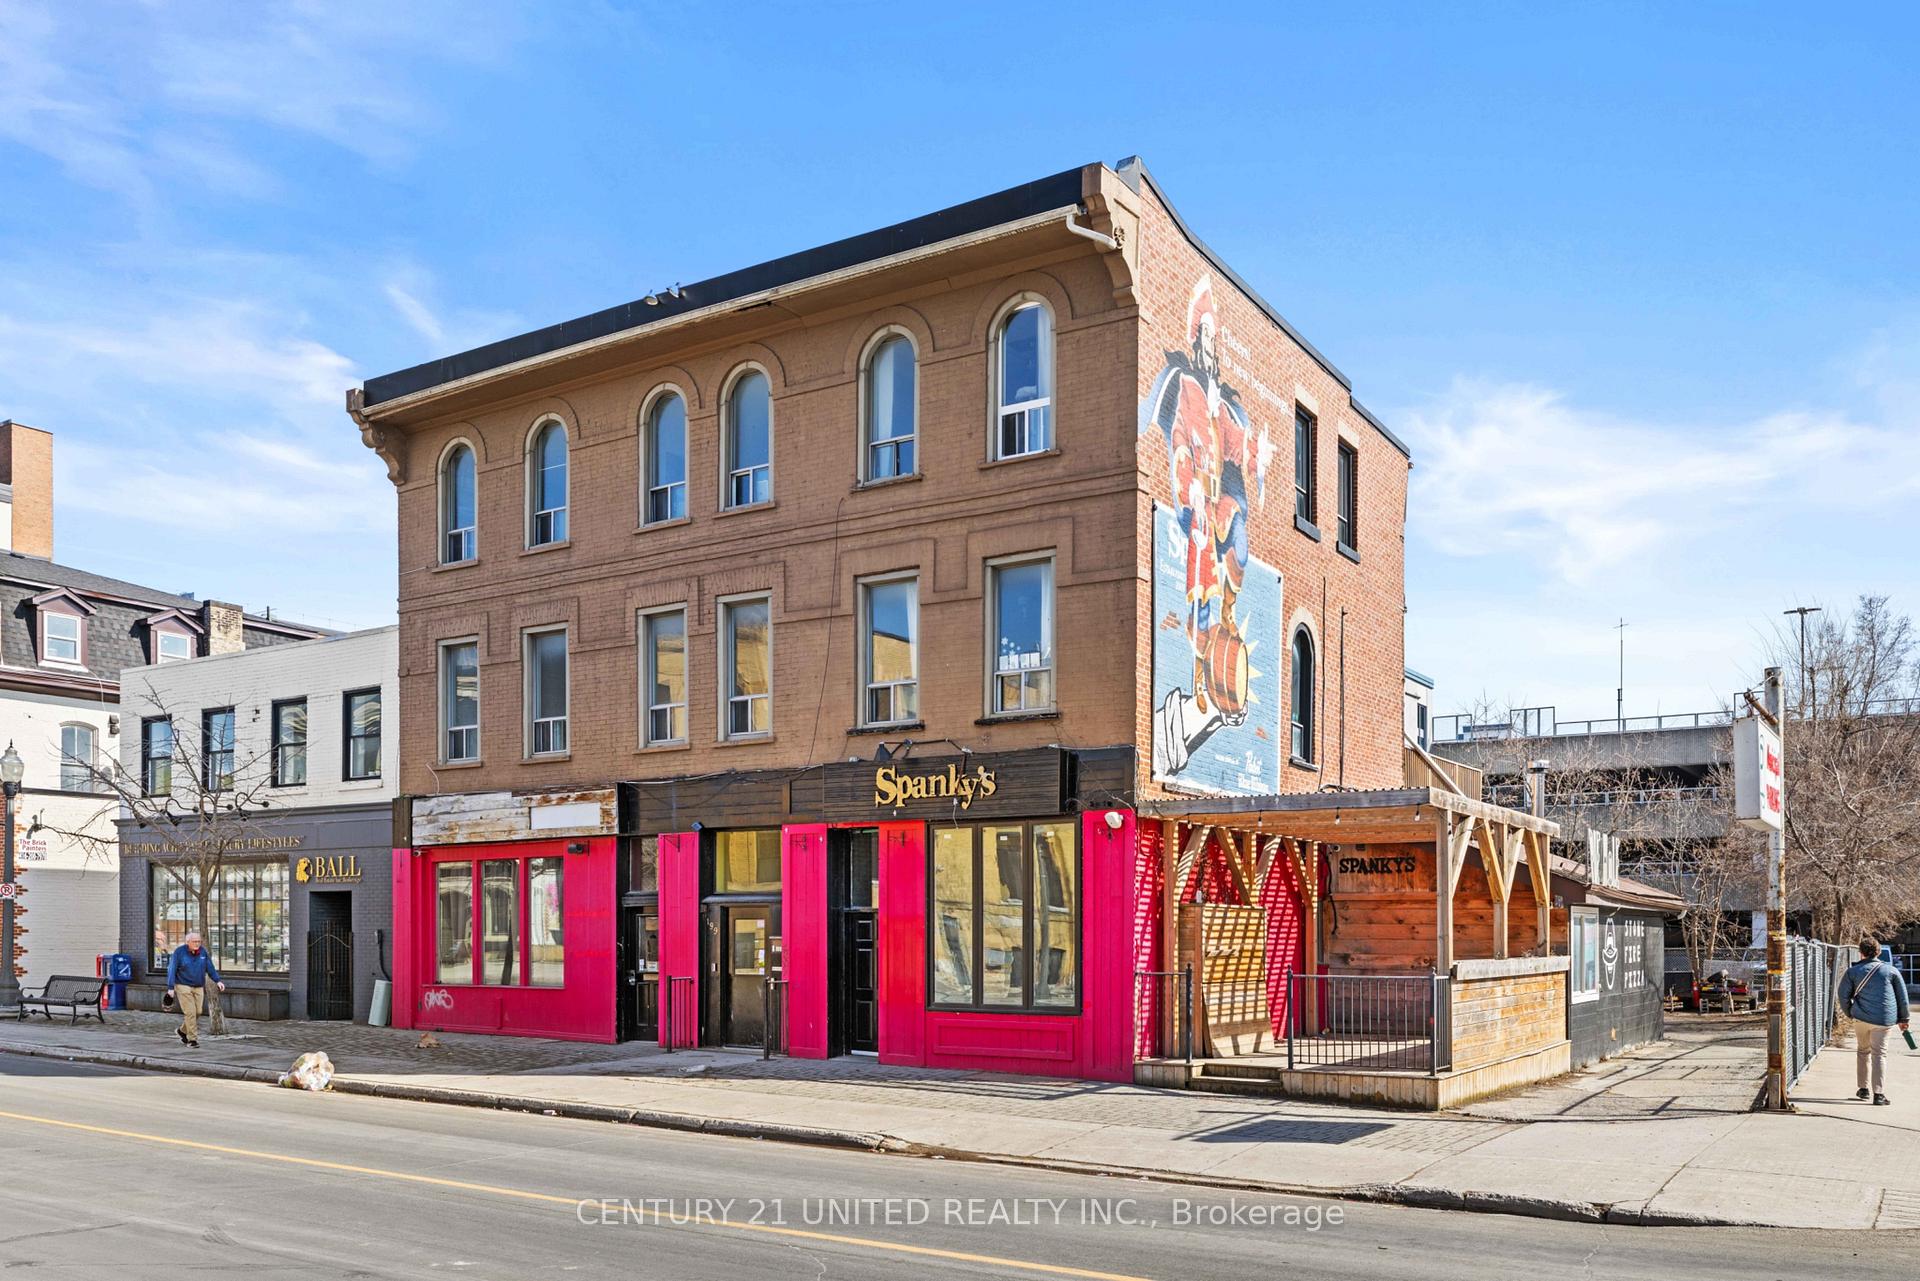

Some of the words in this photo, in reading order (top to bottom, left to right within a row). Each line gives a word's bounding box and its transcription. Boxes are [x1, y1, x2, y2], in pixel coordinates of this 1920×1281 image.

[875, 763, 997, 810] Spanky's
[314, 855, 362, 878] BALL
[1624, 919, 1645, 937] STONE
[1624, 944, 1642, 964] FIRE
[1624, 969, 1645, 989] PIZZA
